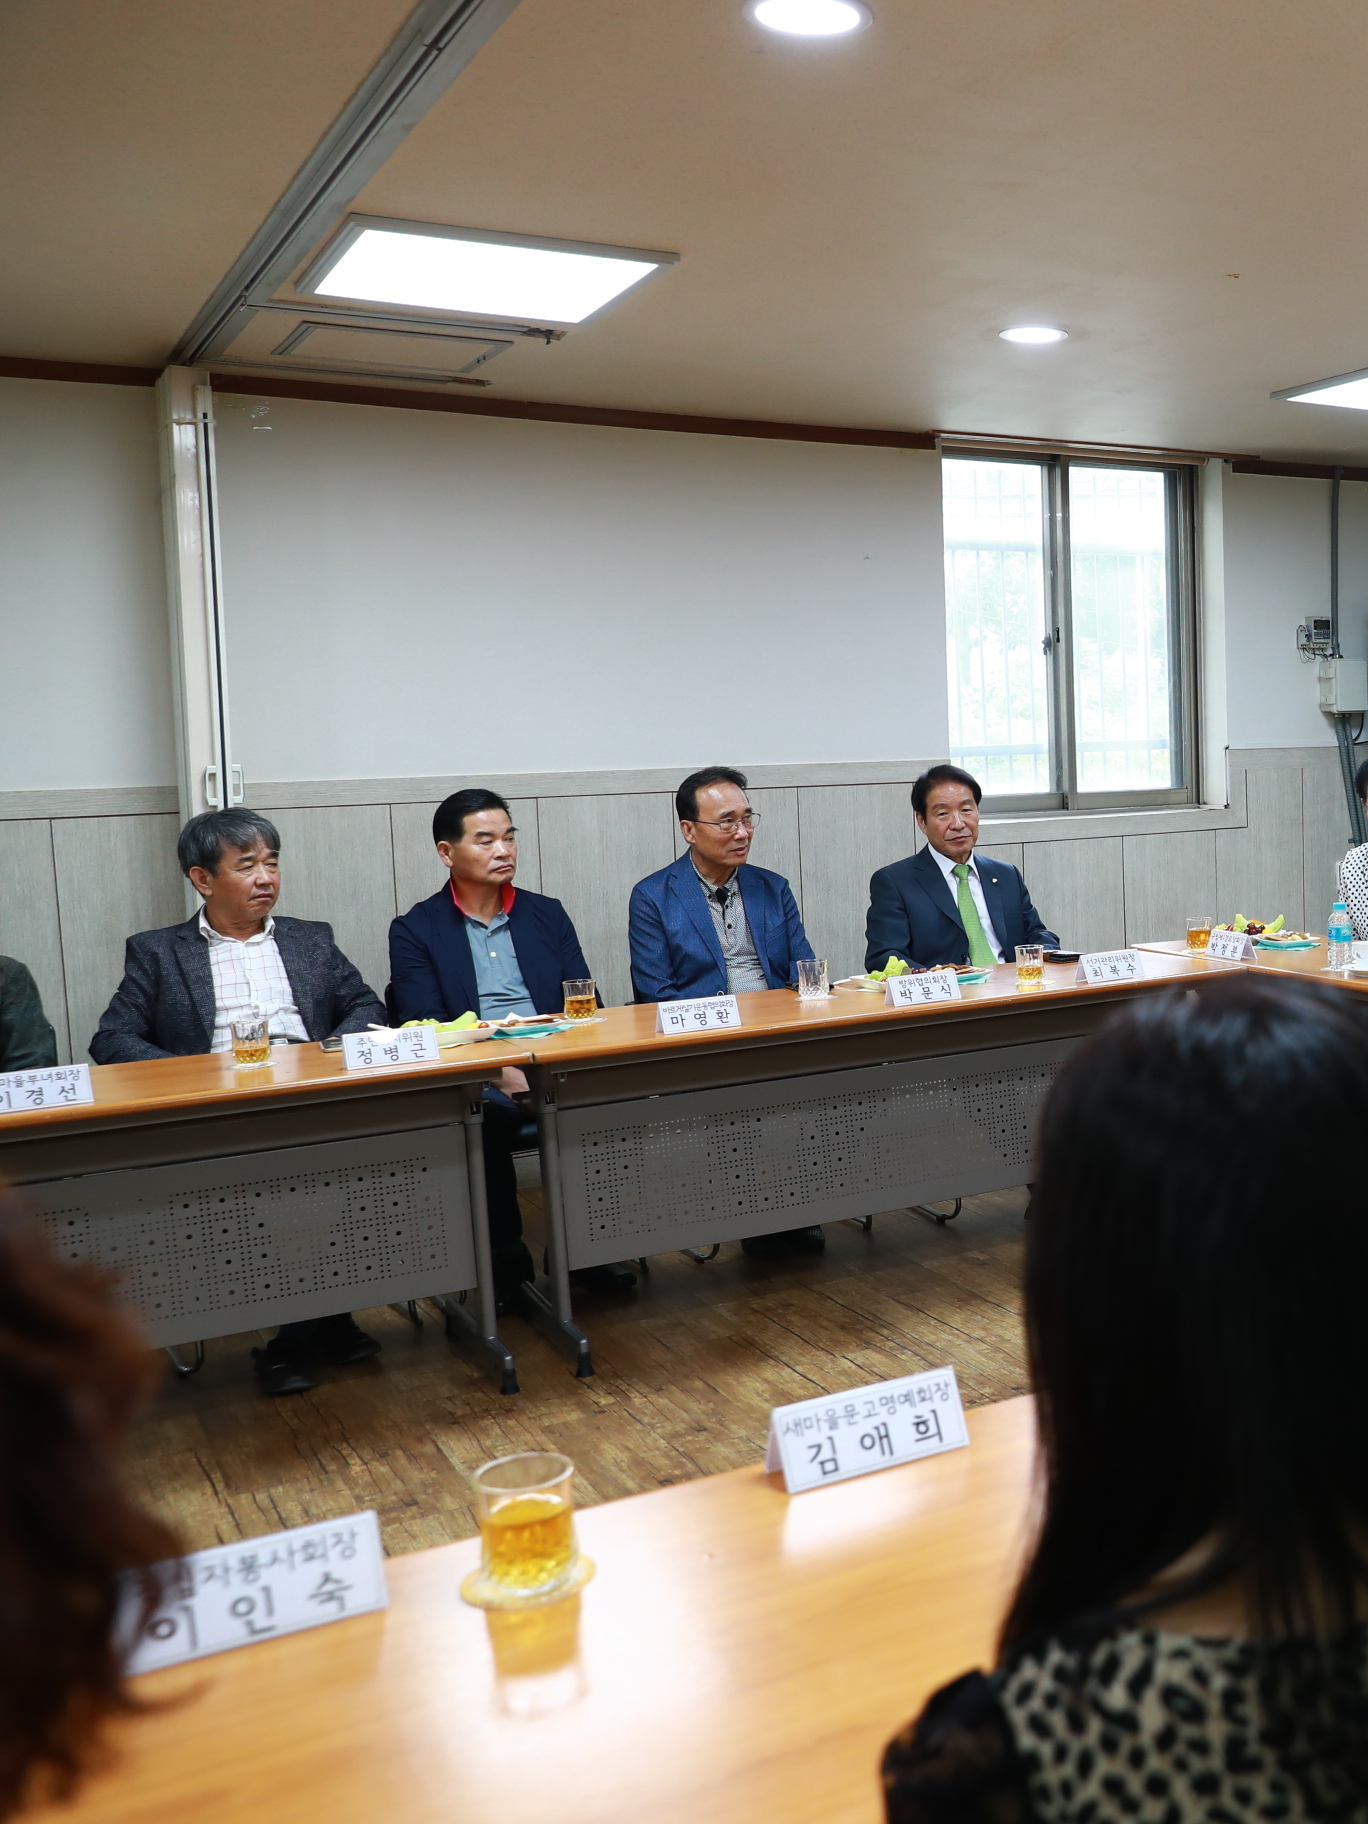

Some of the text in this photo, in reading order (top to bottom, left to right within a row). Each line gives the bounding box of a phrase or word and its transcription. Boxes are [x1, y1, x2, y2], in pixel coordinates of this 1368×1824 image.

[1086, 953, 1135, 968] 선거관리위원장
[1092, 963, 1137, 979] 최복수
[898, 974, 948, 989] 방위협의회장
[899, 983, 952, 1002] 박문식
[670, 1008, 731, 1028] 마영환
[356, 1043, 427, 1065] 정병근
[782, 1379, 951, 1438] 새마을문고명예회장
[807, 1409, 944, 1476] 김애희
[148, 1571, 354, 1651] 이인숙
